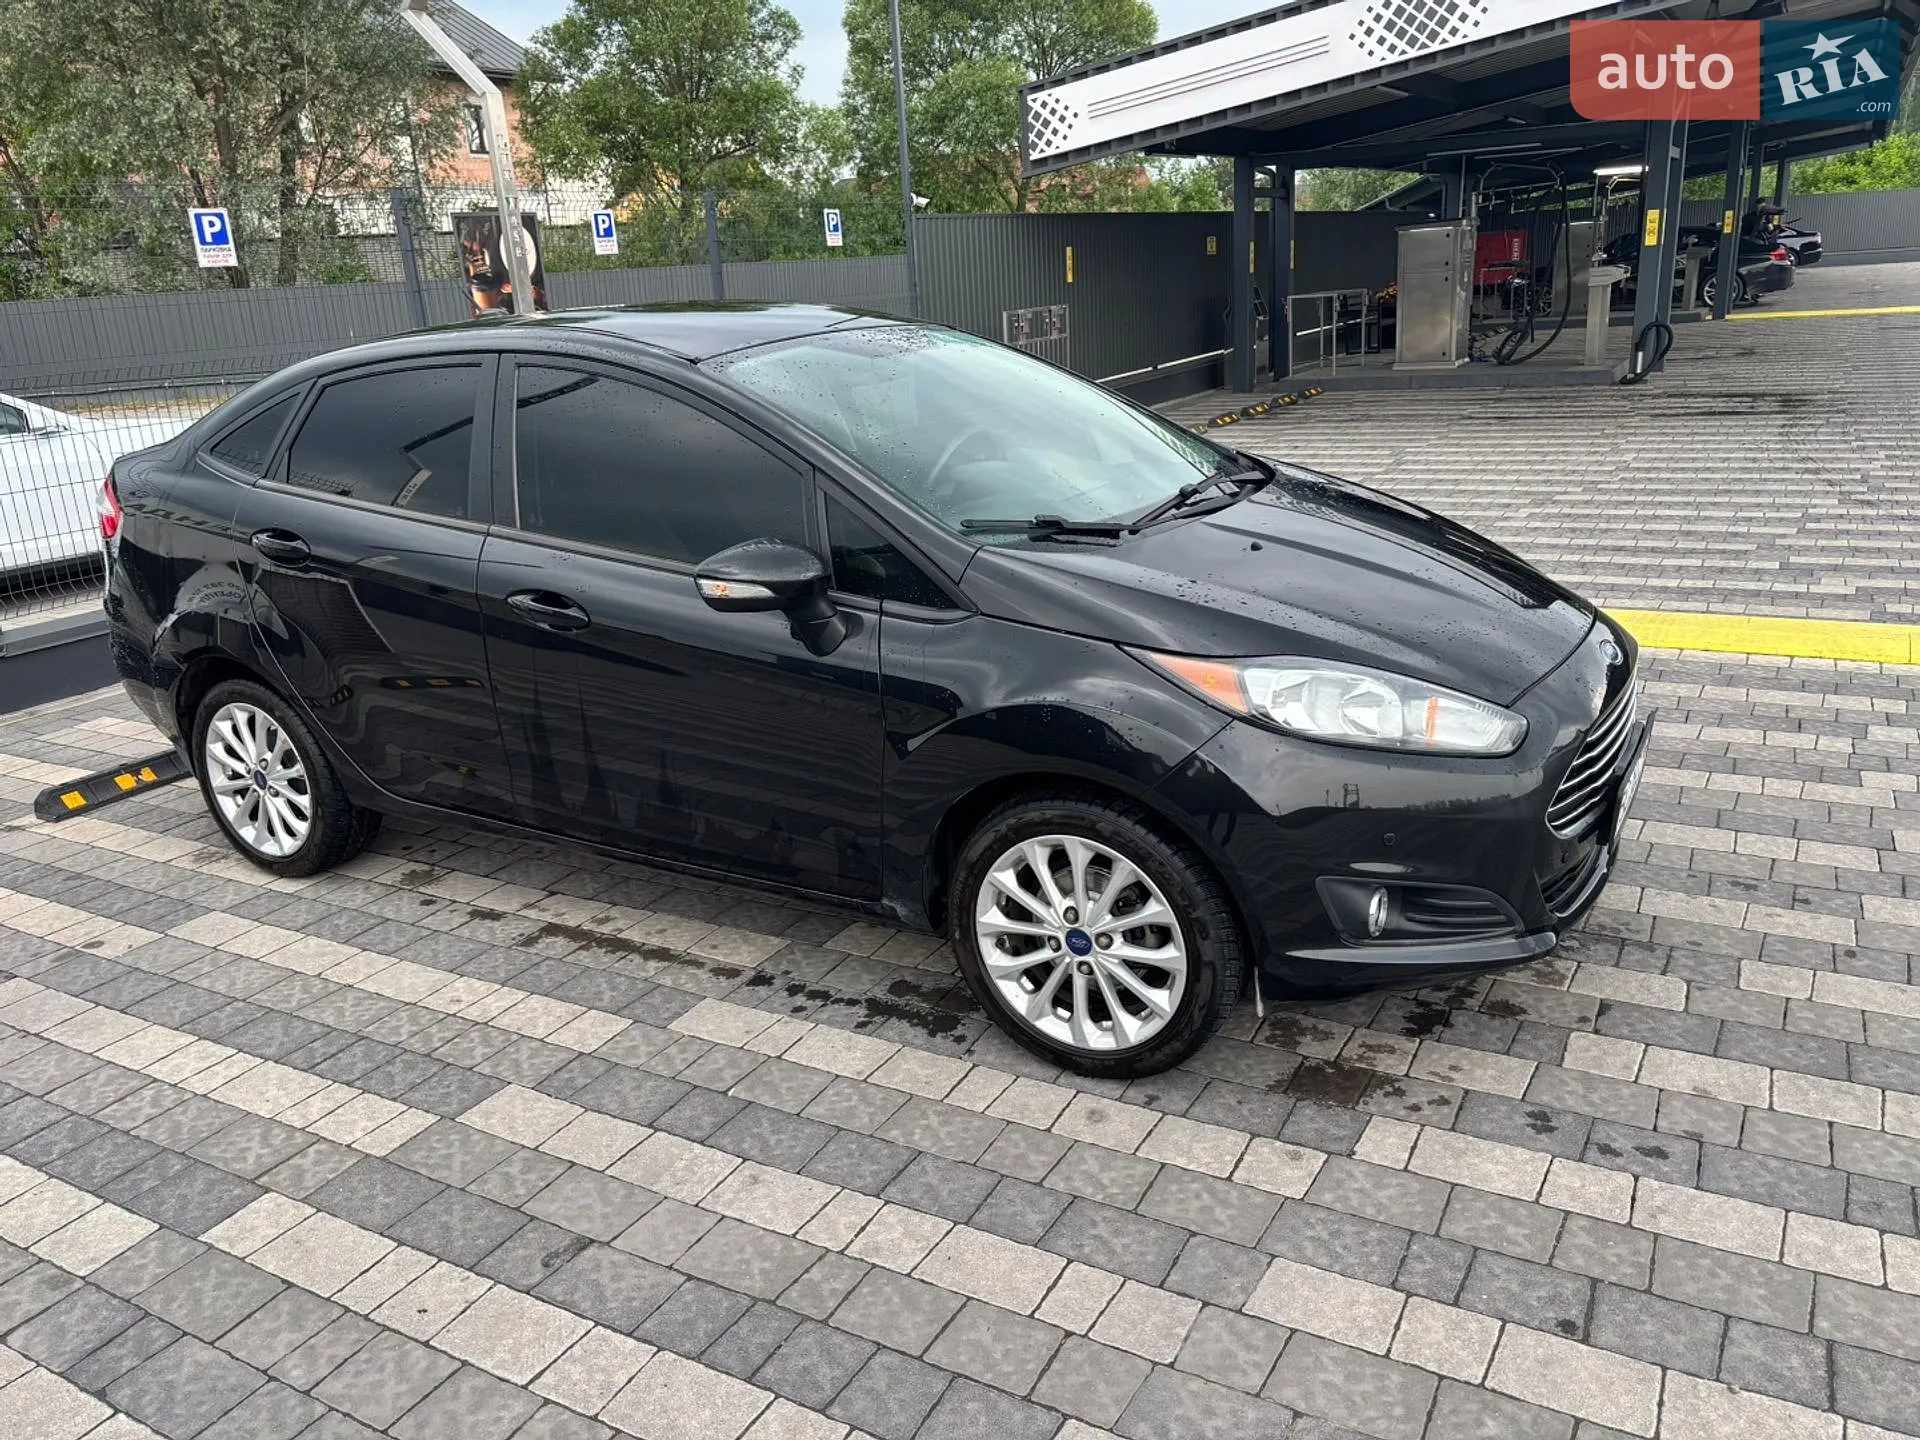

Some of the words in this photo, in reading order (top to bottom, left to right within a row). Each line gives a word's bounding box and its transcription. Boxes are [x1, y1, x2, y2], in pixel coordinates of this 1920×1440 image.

[200, 215, 222, 243] P
[597, 215, 610, 236] P
[828, 214, 837, 232] P
